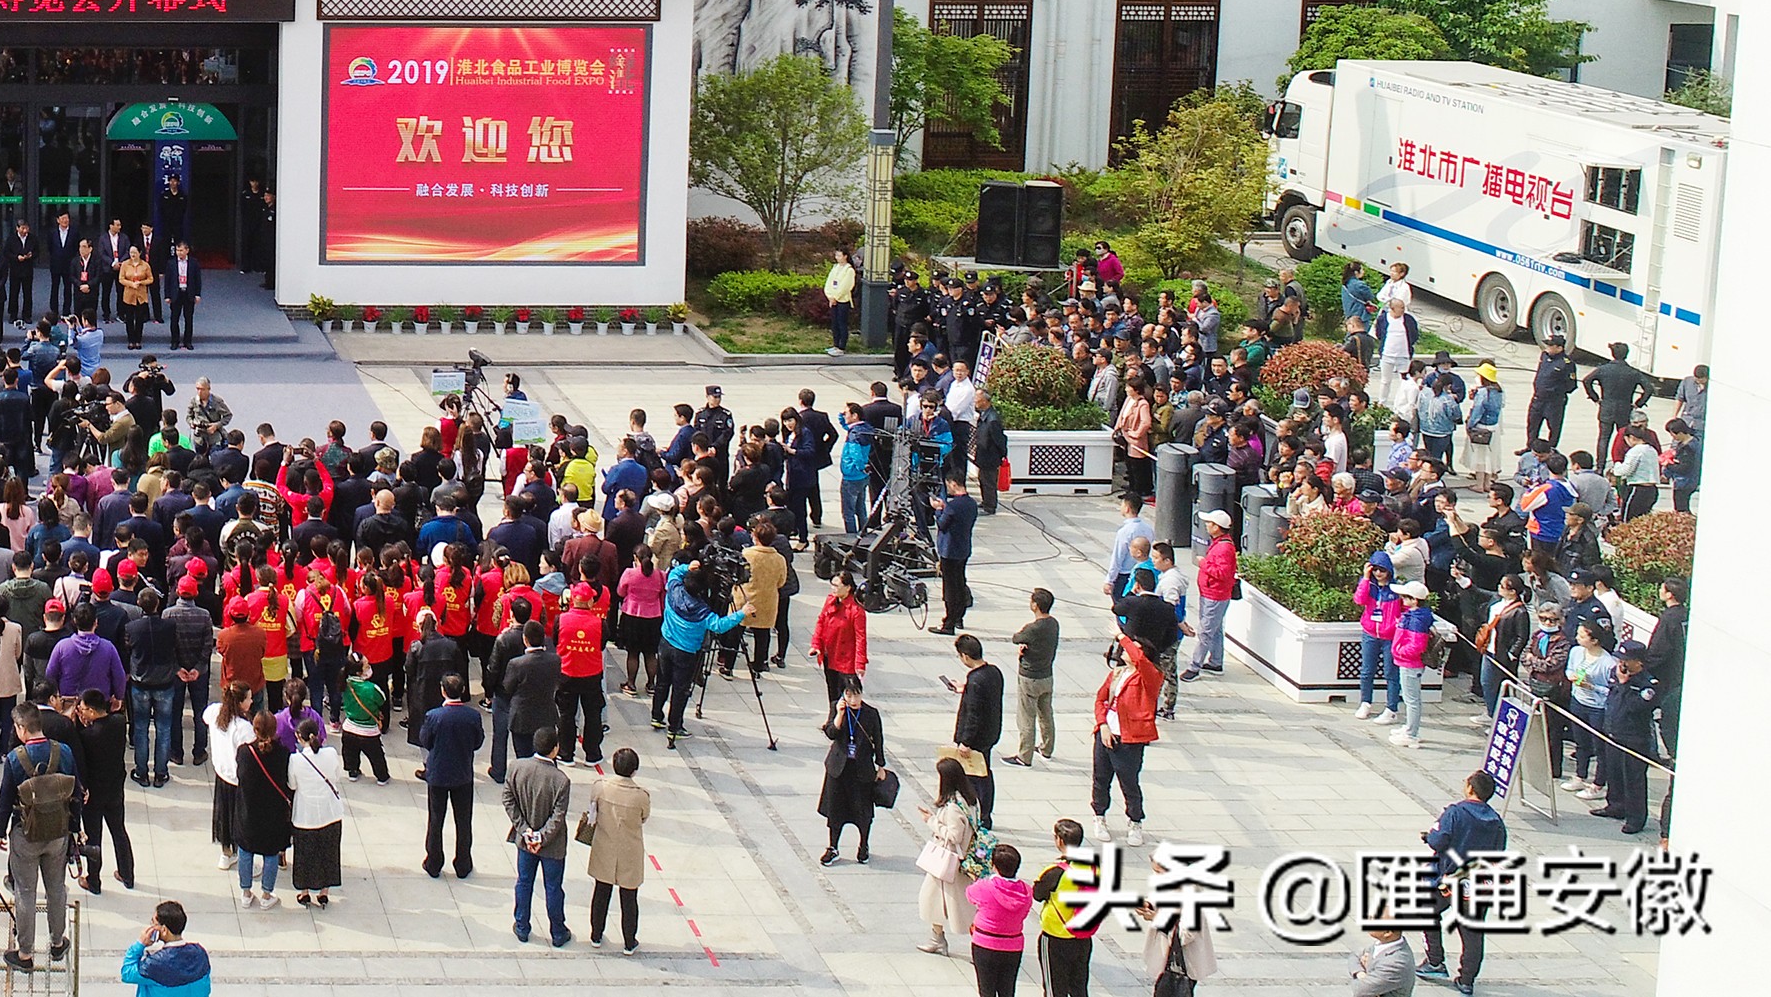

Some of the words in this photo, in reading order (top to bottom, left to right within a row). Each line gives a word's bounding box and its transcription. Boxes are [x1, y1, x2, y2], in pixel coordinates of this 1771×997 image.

[386, 59, 450, 85] 2019
[457, 59, 606, 76] 淮北食品工业博览会
[455, 76, 494, 86] Huaibei
[497, 76, 543, 86] Industrial
[546, 76, 571, 86] Food
[574, 76, 605, 86] EXPO
[1403, 85, 1425, 99] RADIO
[1425, 92, 1441, 104] AND
[1441, 95, 1453, 106] TV
[1452, 99, 1485, 114] STATION
[396, 116, 575, 164] 欢迎您
[1396, 136, 1575, 221] 淮北市广播电视台
